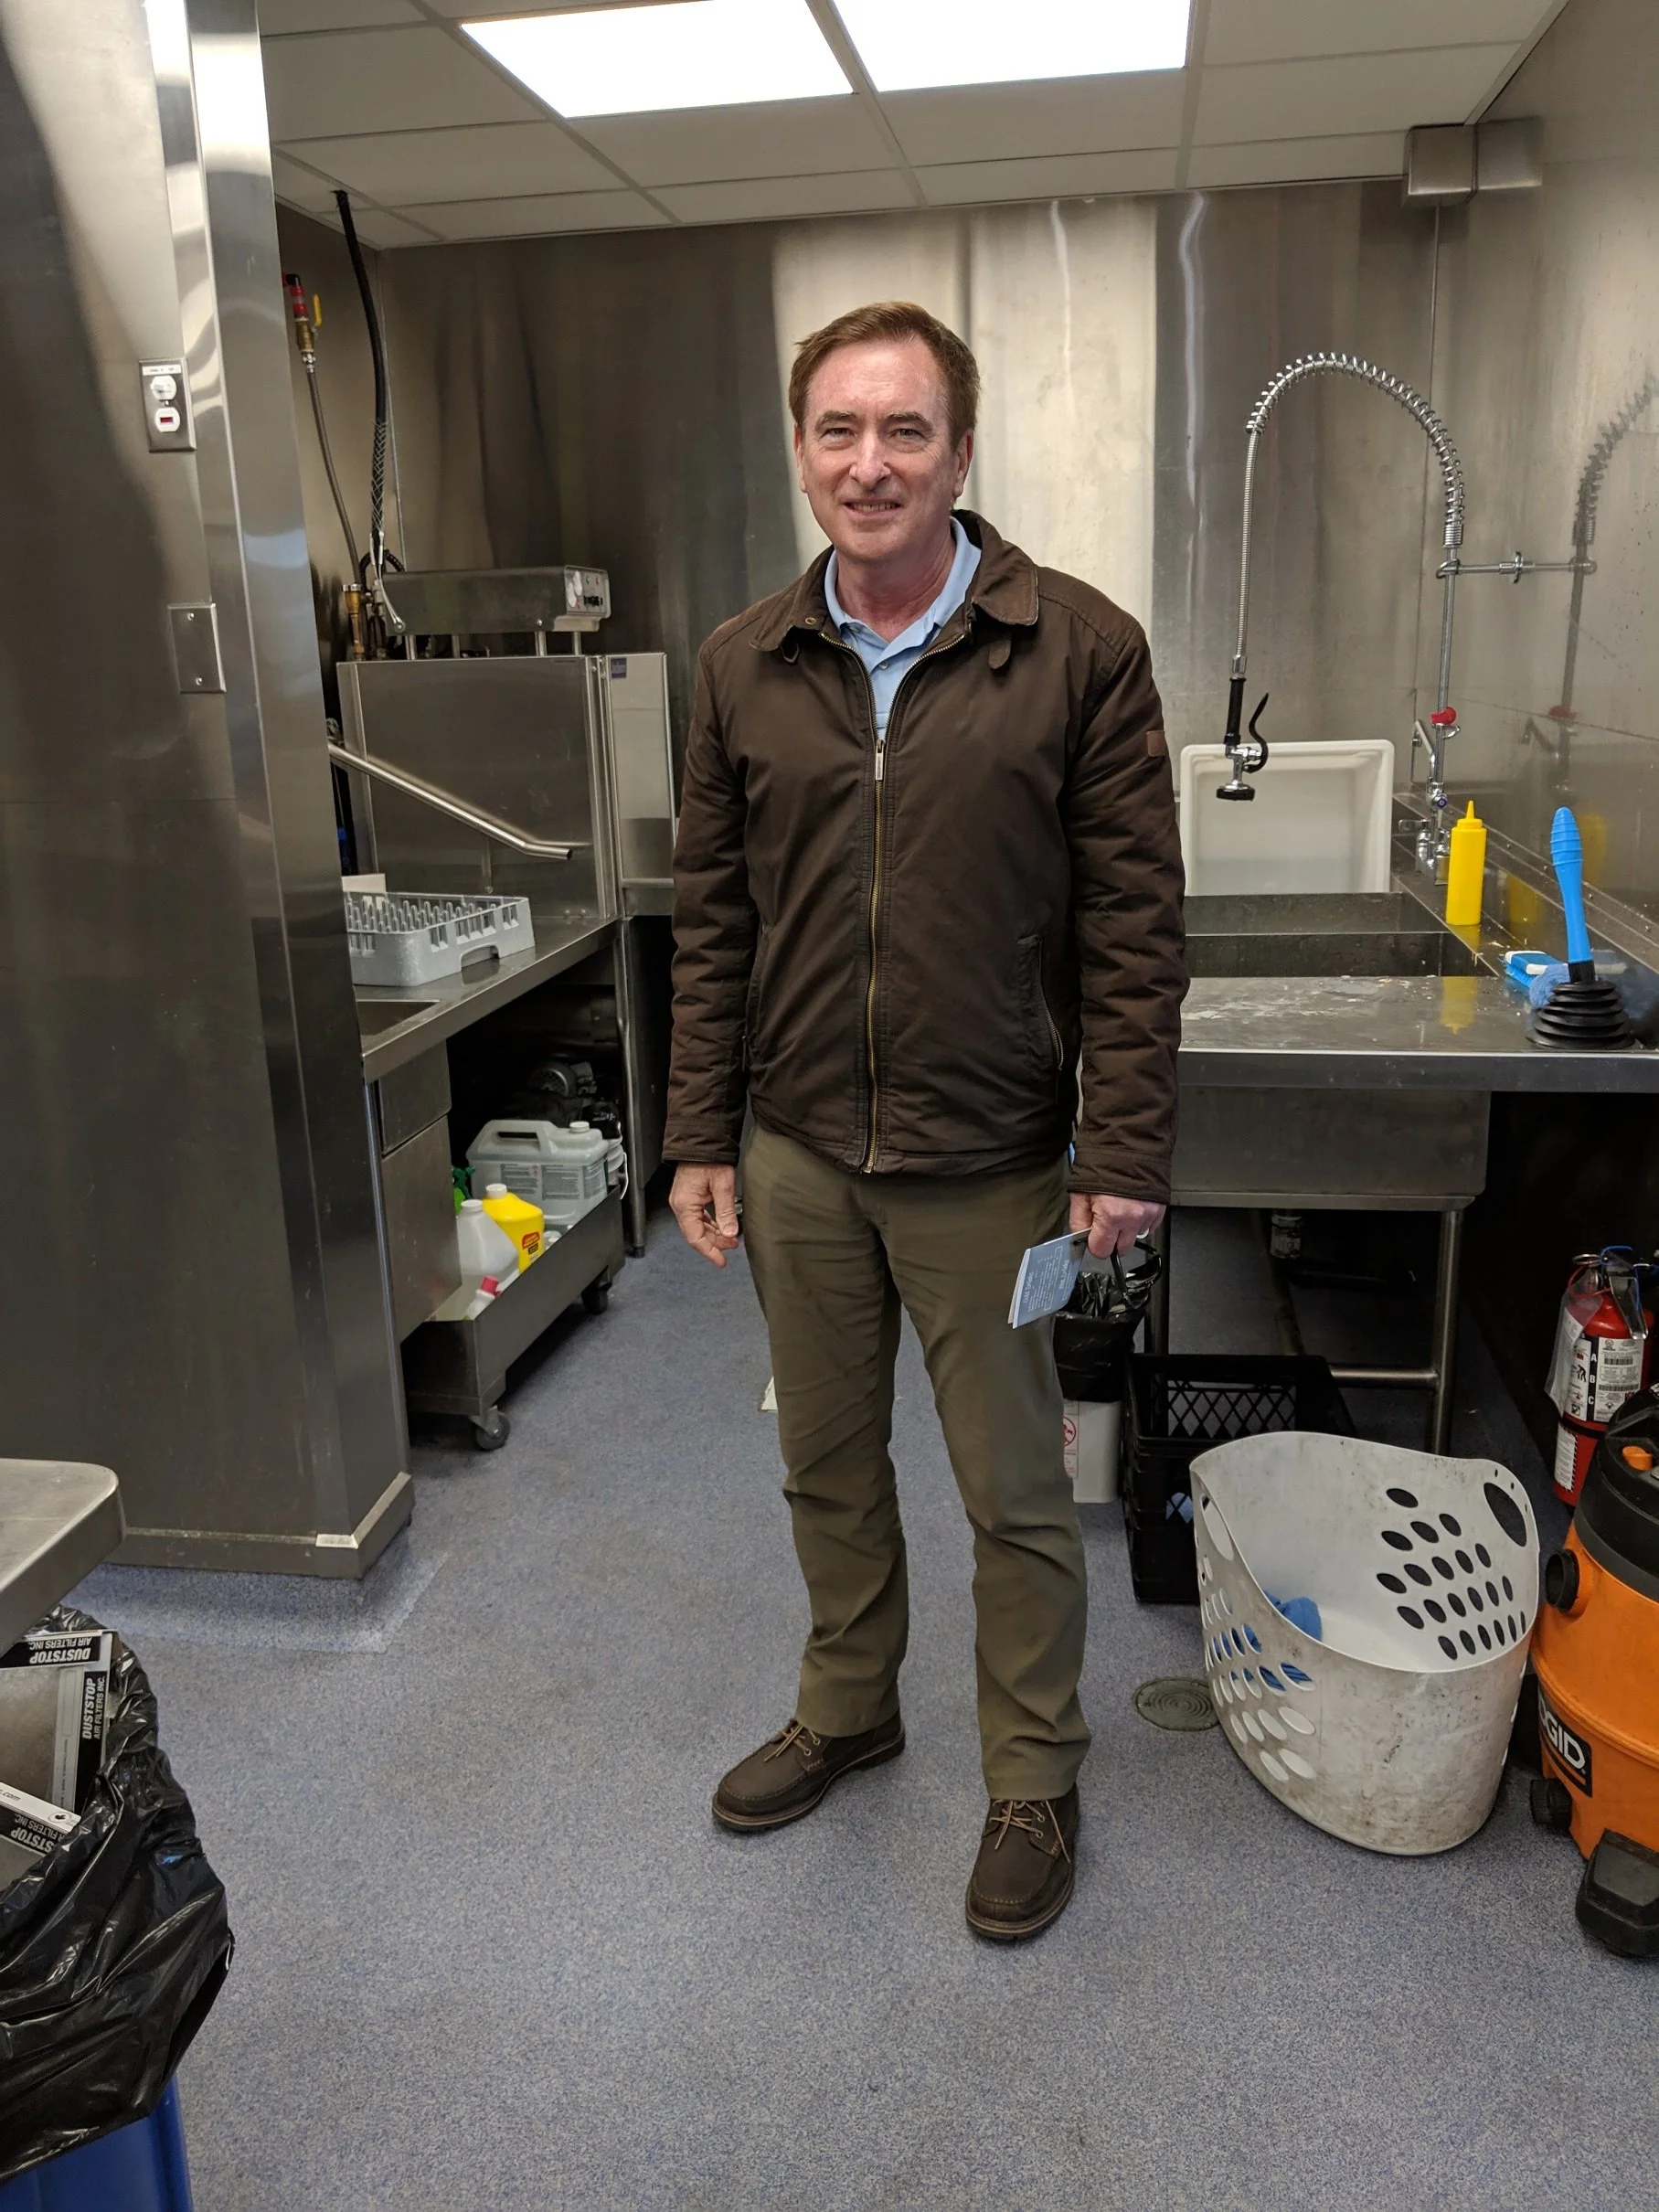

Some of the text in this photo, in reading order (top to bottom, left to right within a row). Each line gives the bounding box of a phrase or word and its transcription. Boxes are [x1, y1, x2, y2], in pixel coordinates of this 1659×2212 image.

[1588, 1354, 1597, 1405] A B C
[28, 1637, 92, 1651] AIR FILTERS INC.
[29, 1648, 91, 1664] DUSTSTOP
[82, 1678, 96, 1739] DUSTSTOP
[93, 1676, 106, 1739] AIR FILTERS INC.
[1538, 1690, 1586, 1770] DGID
[11, 1826, 55, 1853] STSTOP
[27, 1820, 58, 1840] FILTERS
